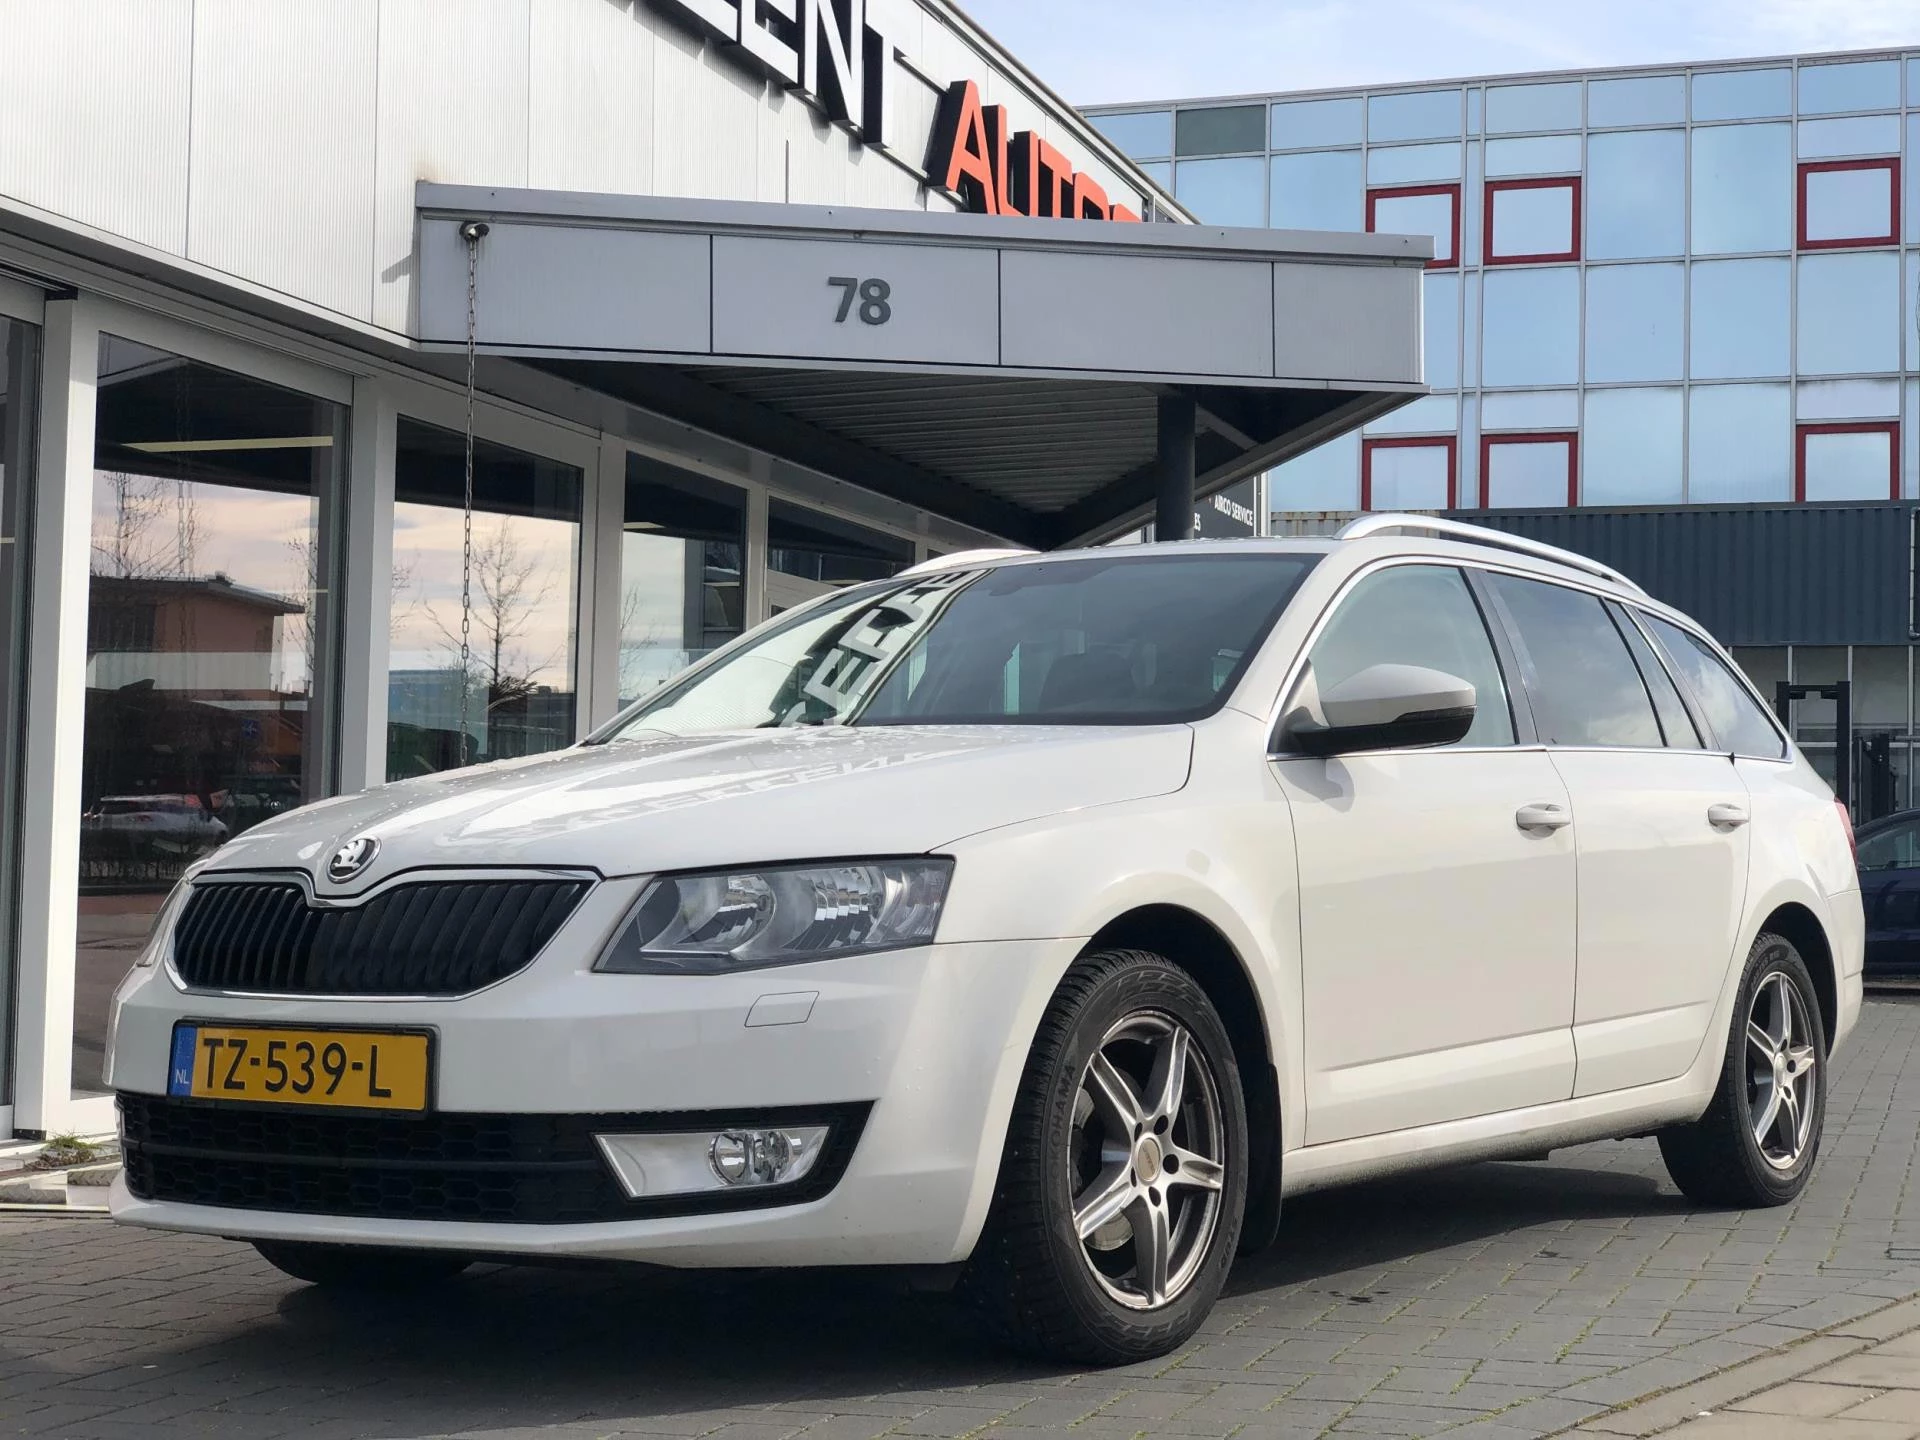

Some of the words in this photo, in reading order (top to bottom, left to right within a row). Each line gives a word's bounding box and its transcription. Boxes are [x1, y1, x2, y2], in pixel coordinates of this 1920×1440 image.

[828, 276, 891, 325] 78
[1214, 493, 1232, 516] AIRCO
[1232, 501, 1254, 527] SERVICE
[175, 1068, 189, 1084] NL
[203, 1038, 392, 1098] TZ-539-L
